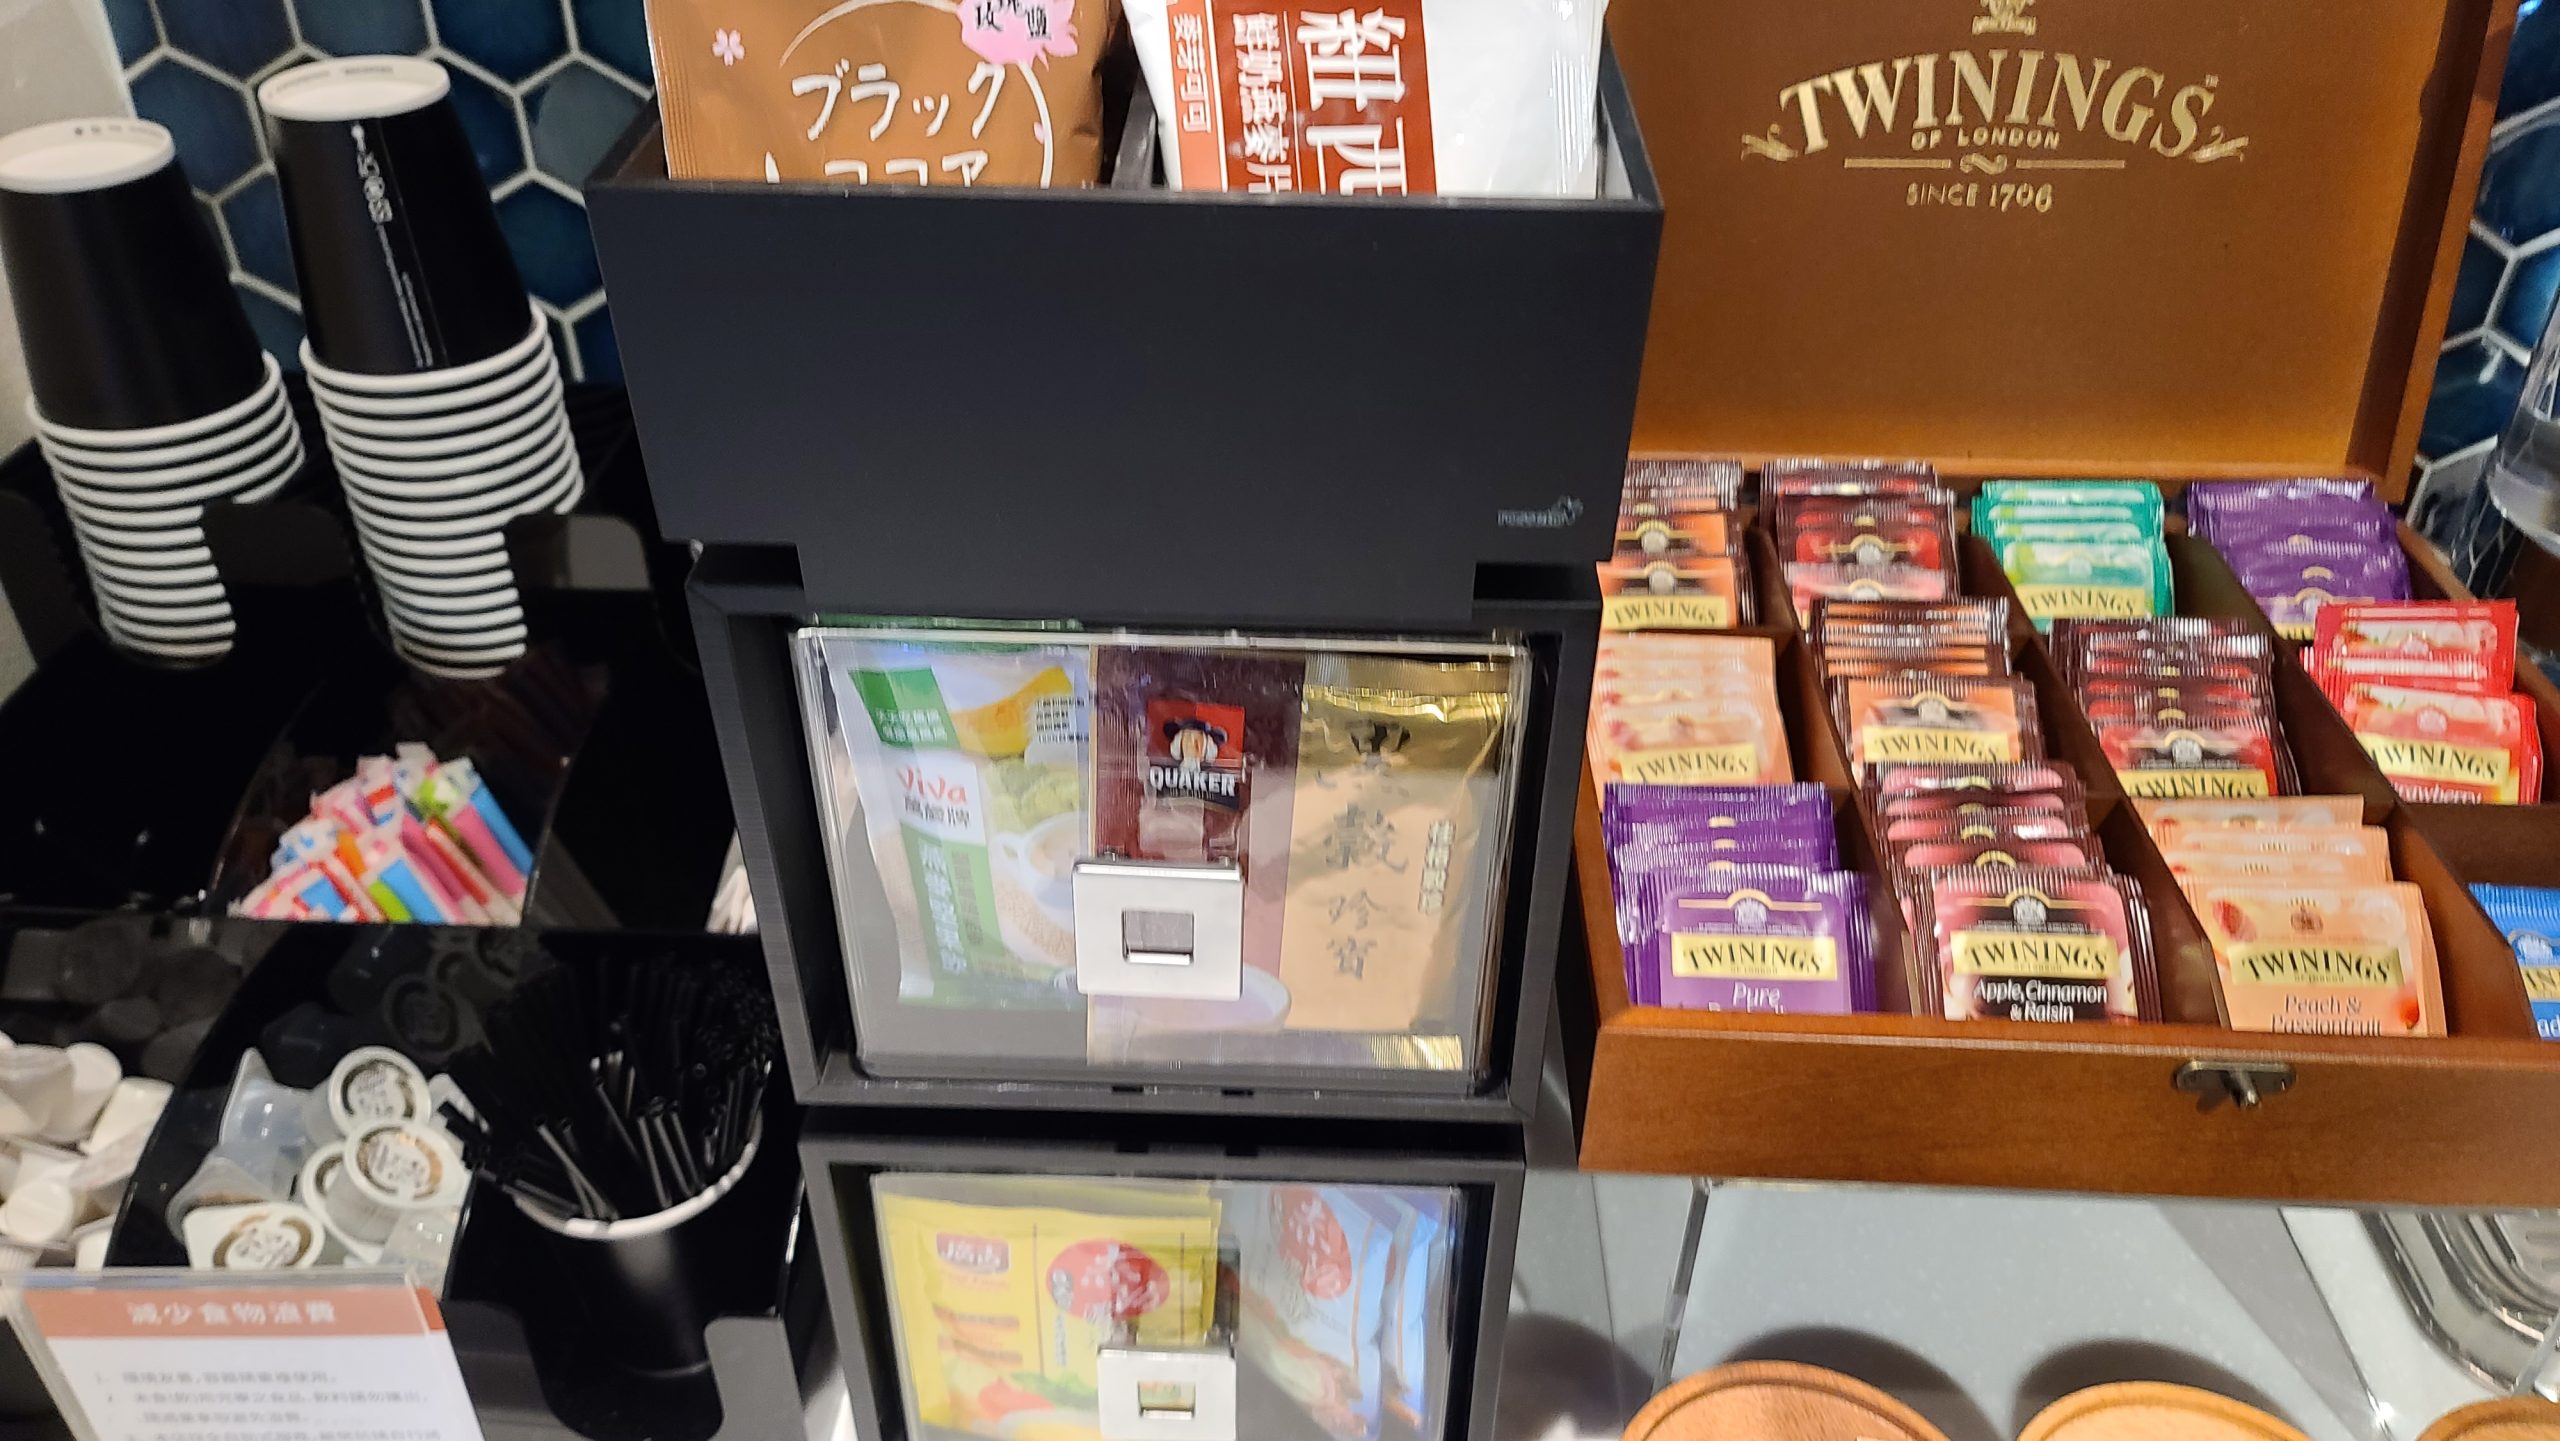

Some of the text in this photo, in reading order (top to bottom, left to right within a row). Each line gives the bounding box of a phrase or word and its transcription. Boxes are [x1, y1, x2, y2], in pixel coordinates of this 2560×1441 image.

[1173, 13, 1212, 133] 麥芽可可
[792, 58, 1006, 142] ブラック
[1779, 49, 2213, 157] TWININGS
[1911, 126, 2060, 150] OF LONDON
[1906, 182, 2053, 213] SINCE 1706
[1614, 599, 1719, 625] TWININGS
[2028, 588, 2136, 616] TWININGS
[1876, 733, 2000, 763] TWININGS
[1150, 765, 1236, 797] QUAKER
[1631, 752, 1751, 784] TWININGS
[1683, 942, 1823, 974] TWININGS
[1966, 940, 2107, 973] TWININGS
[2242, 949, 2391, 982] TWININGS
[1733, 982, 1780, 1013] Pure
[2025, 979, 2108, 1005] Cinnamon
[2285, 994, 2362, 1016] Peach &
[2024, 1001, 2074, 1024] Raisin
